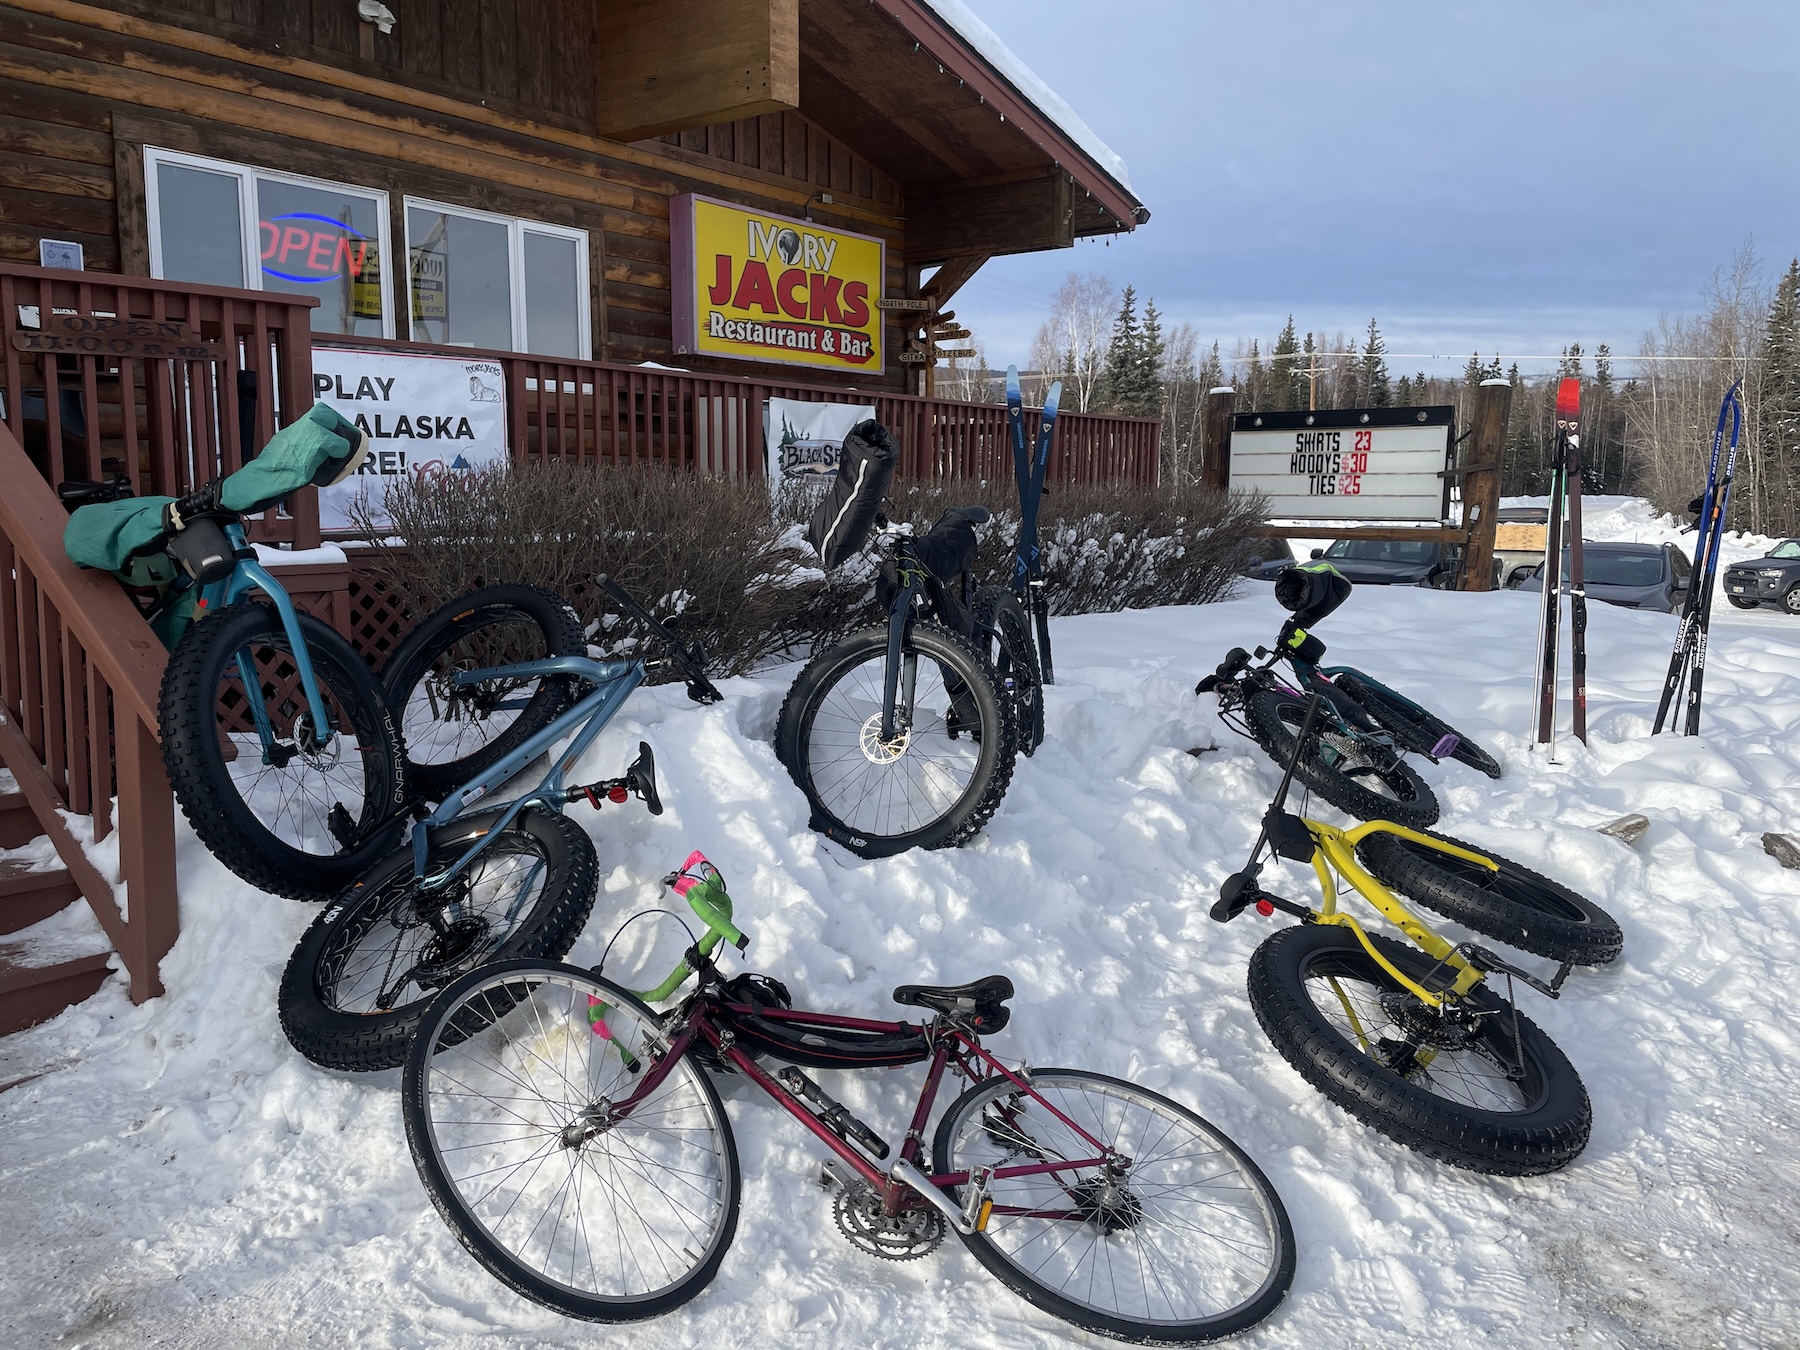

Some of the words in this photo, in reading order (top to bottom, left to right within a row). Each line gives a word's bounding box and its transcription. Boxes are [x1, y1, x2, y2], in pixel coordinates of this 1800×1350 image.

[259, 221, 367, 277] OPEN
[747, 219, 838, 273] IVORY
[708, 253, 870, 328] JACKS
[880, 300, 904, 308] NORTH
[906, 301, 923, 309] POLE
[62, 316, 184, 338] OPEN
[709, 311, 817, 351] Restaurant
[820, 329, 835, 354] &
[839, 331, 870, 357] Bar
[902, 353, 925, 361] SITKA
[314, 373, 396, 402] PLAY
[355, 413, 475, 440] ALASKA
[1296, 432, 1341, 453] SHIRTS
[1290, 453, 1341, 474] HOODYS
[1309, 475, 1336, 495] TIES
[383, 707, 404, 804] GNARWHAL
